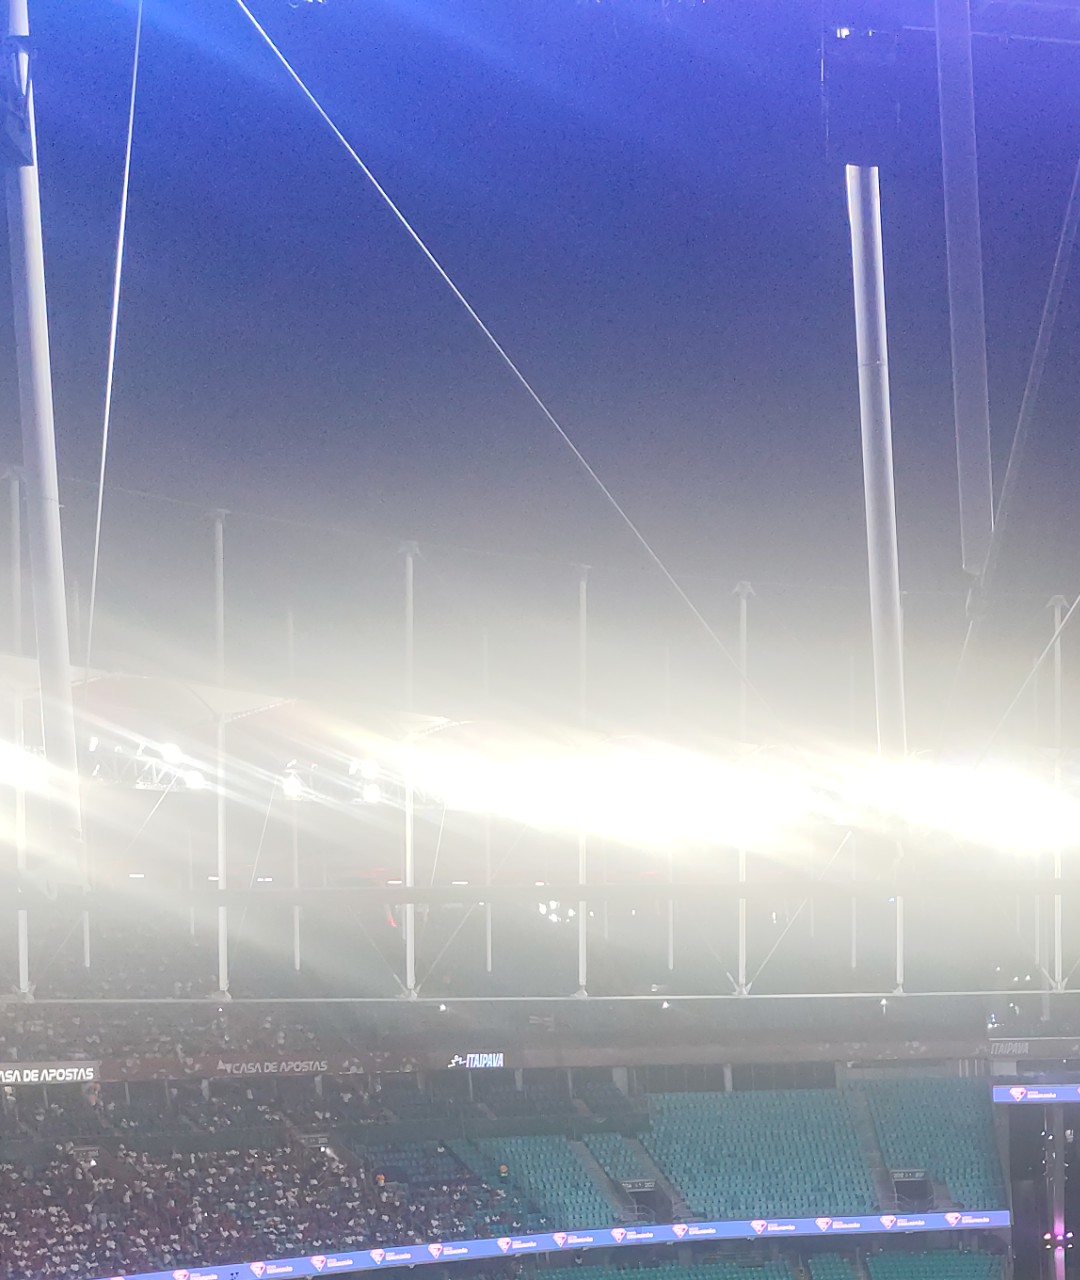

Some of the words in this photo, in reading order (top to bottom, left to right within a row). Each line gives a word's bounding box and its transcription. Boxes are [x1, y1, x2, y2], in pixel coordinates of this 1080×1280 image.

[990, 1042, 1029, 1055] ITAIPAVA
[232, 1063, 262, 1074] CASA
[264, 1062, 278, 1073] DE
[280, 1060, 328, 1072] APOSTAS
[466, 1052, 503, 1068] ITAIPAVA
[23, 1070, 39, 1082] DE
[40, 1067, 94, 1081] APOSTAS
